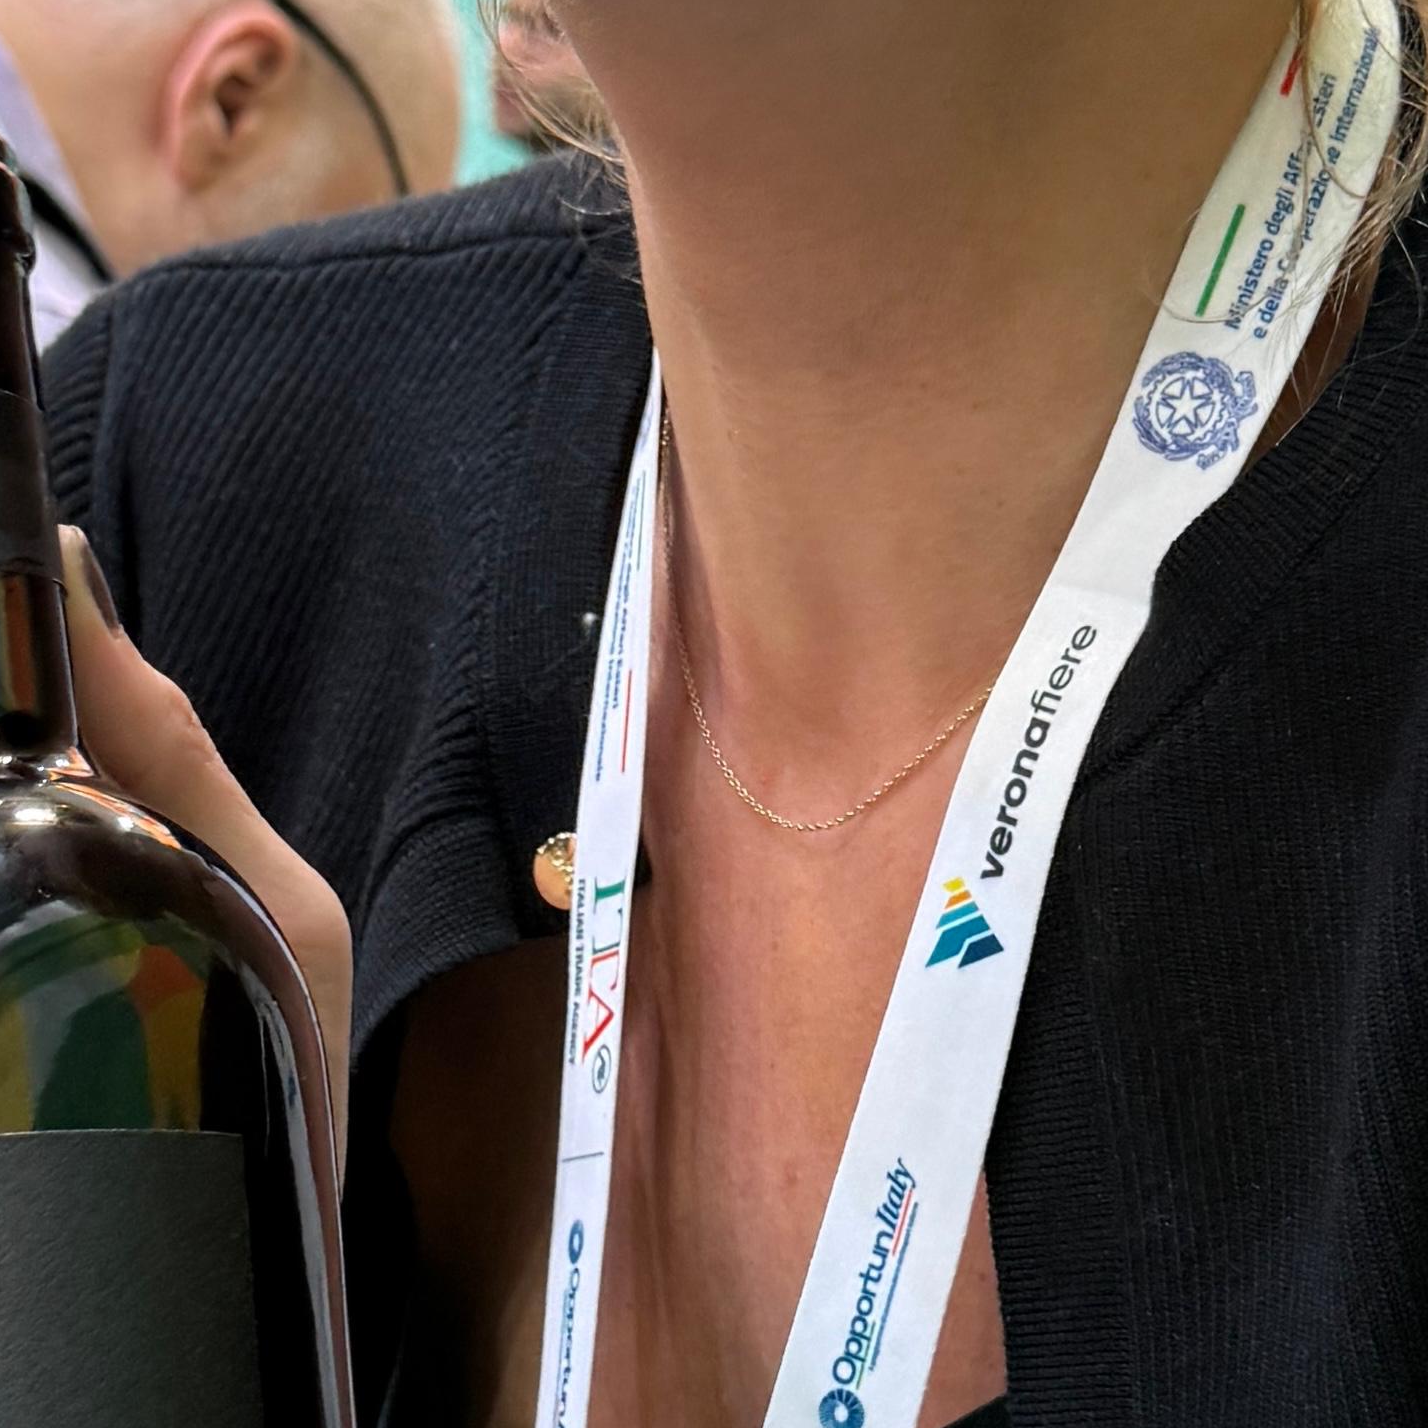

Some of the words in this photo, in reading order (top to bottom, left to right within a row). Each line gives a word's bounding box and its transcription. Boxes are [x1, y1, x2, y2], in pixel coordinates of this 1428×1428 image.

[1225, 239, 1274, 330] Ministero
[1265, 187, 1295, 235] degli
[1313, 72, 1338, 129] steri
[1253, 325, 1268, 340] e
[980, 624, 1097, 880] veronafiere
[832, 1157, 916, 1386] OpportunItaly
